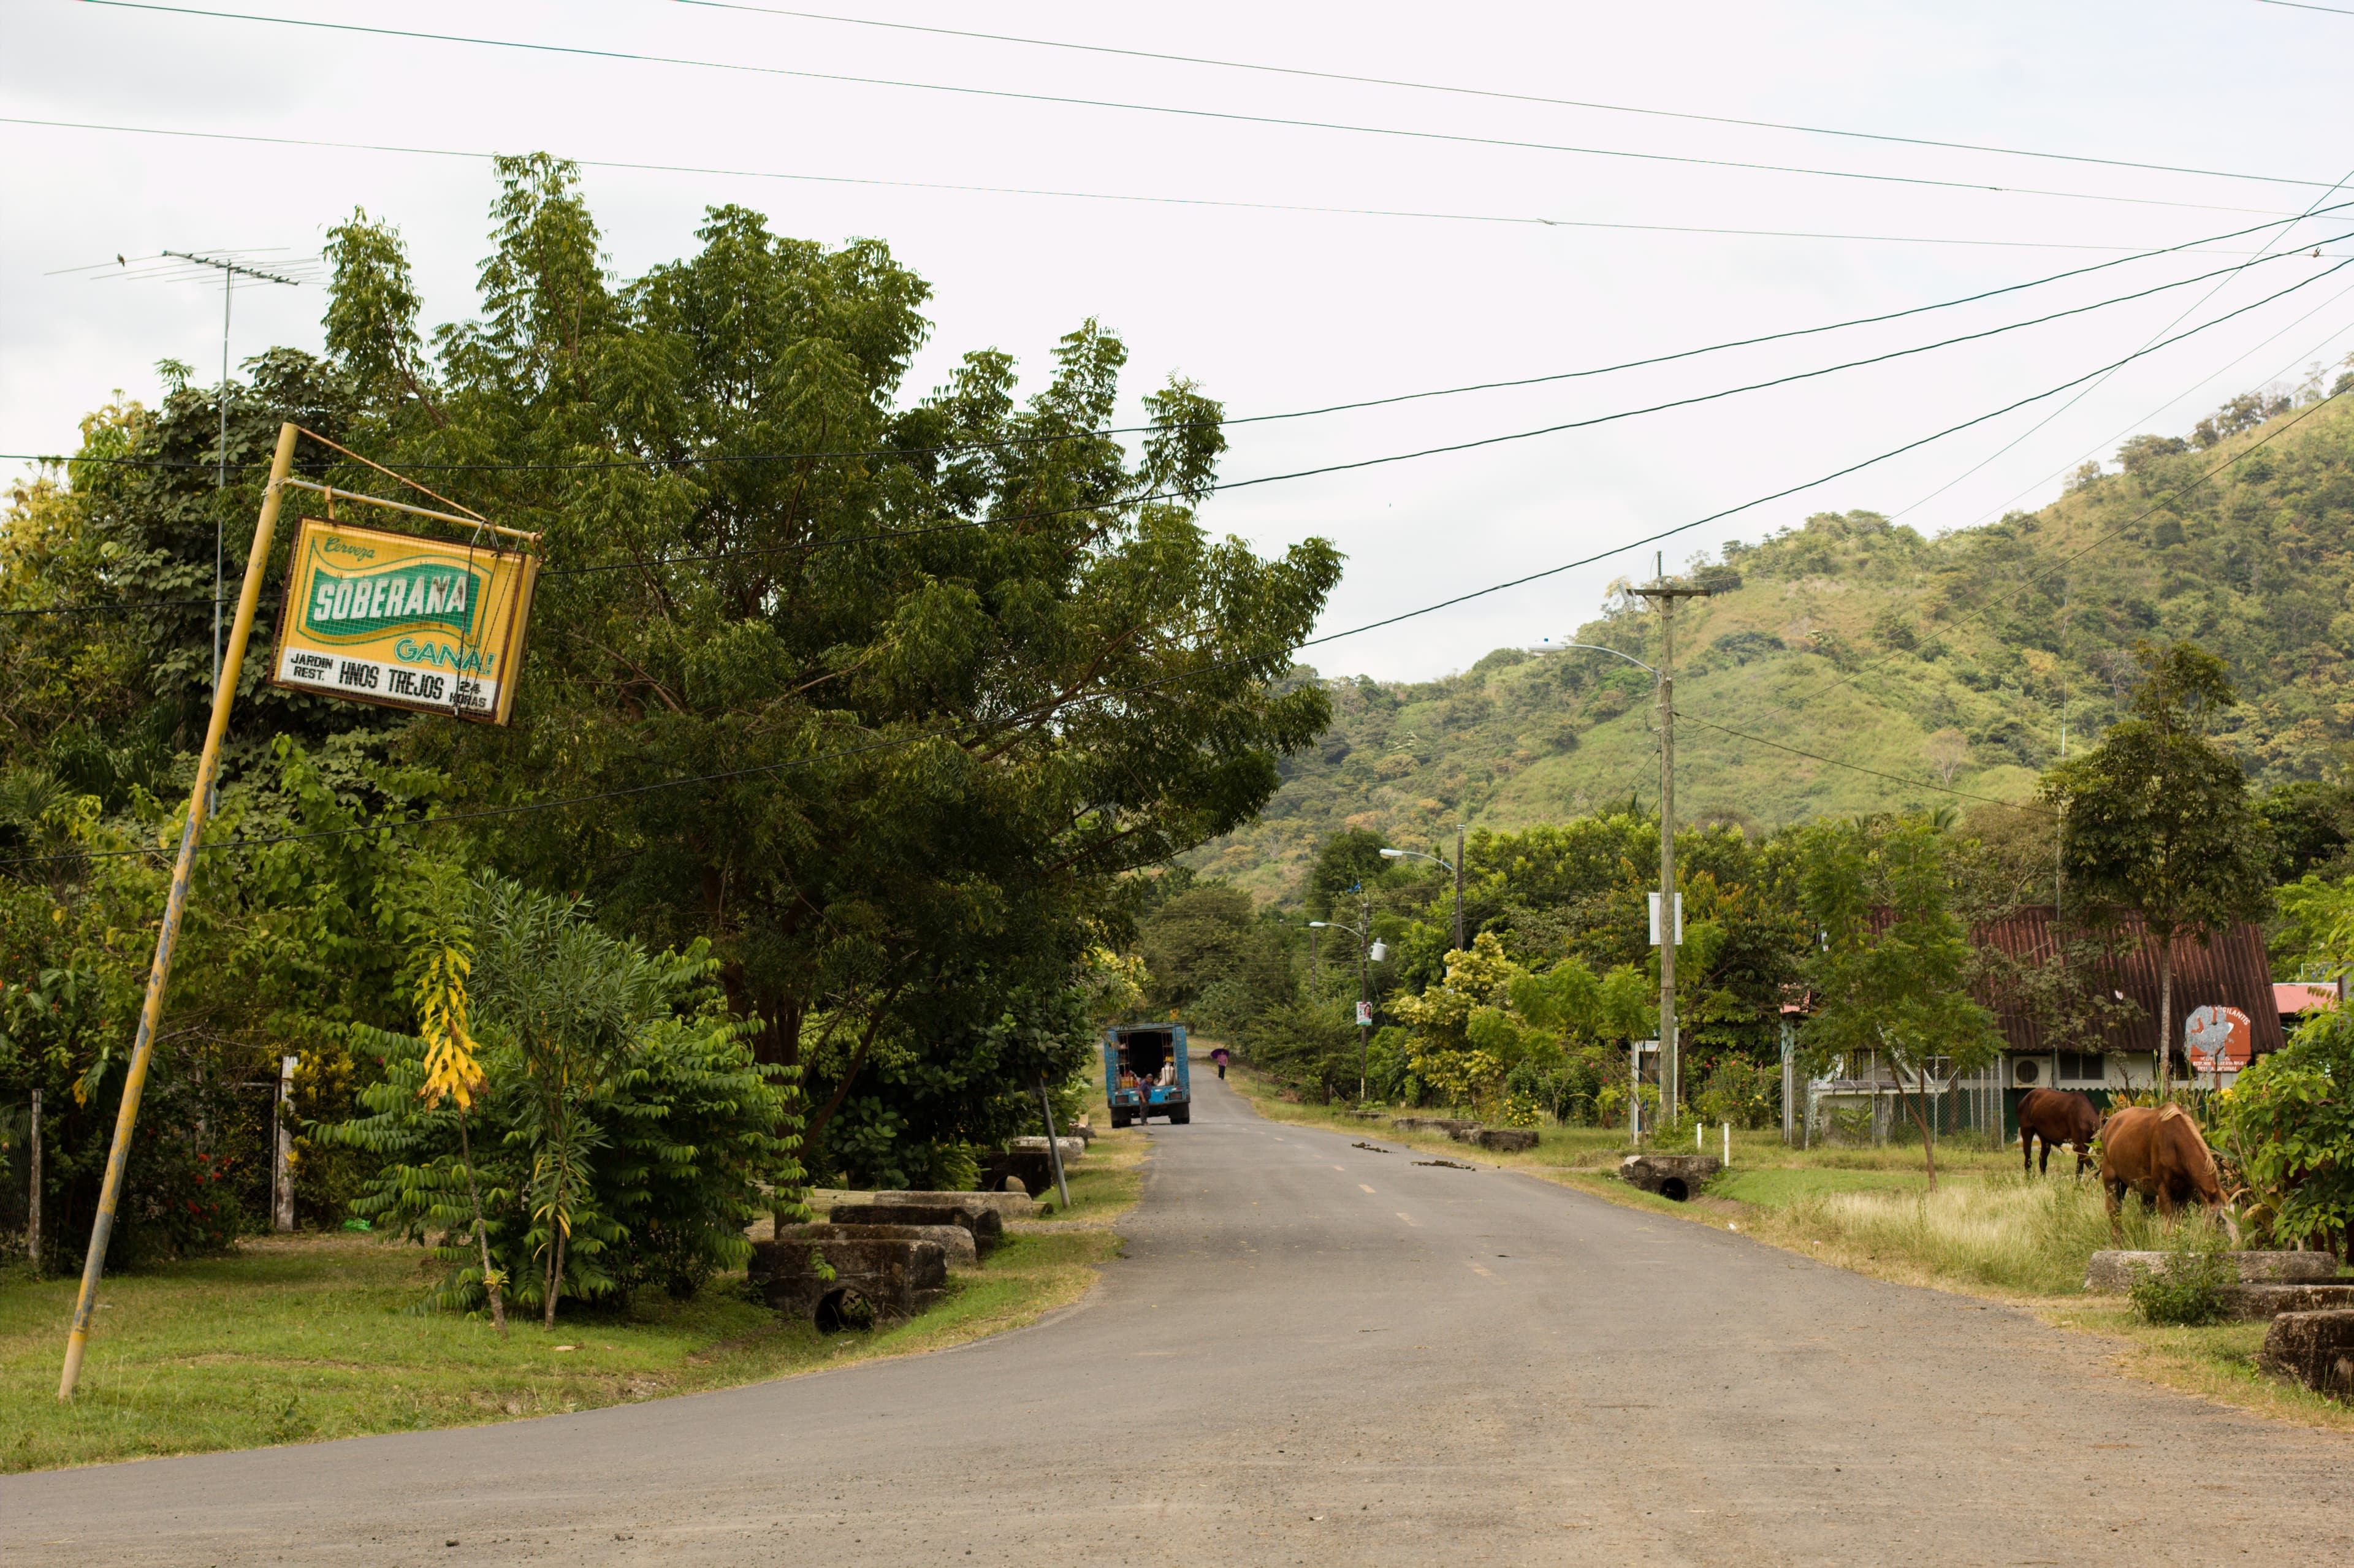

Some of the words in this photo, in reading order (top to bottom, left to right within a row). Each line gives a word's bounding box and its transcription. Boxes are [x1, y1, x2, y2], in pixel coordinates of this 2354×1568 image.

[324, 536, 375, 561] Cerveza
[313, 576, 467, 621] SOBERANA
[291, 653, 333, 669] JARDIN
[394, 637, 496, 676] GANA!
[294, 666, 325, 681] REST.
[339, 661, 379, 689] HNOS
[389, 668, 444, 700] TREJOS
[459, 680, 481, 695] 24
[449, 692, 487, 708] HORAS
